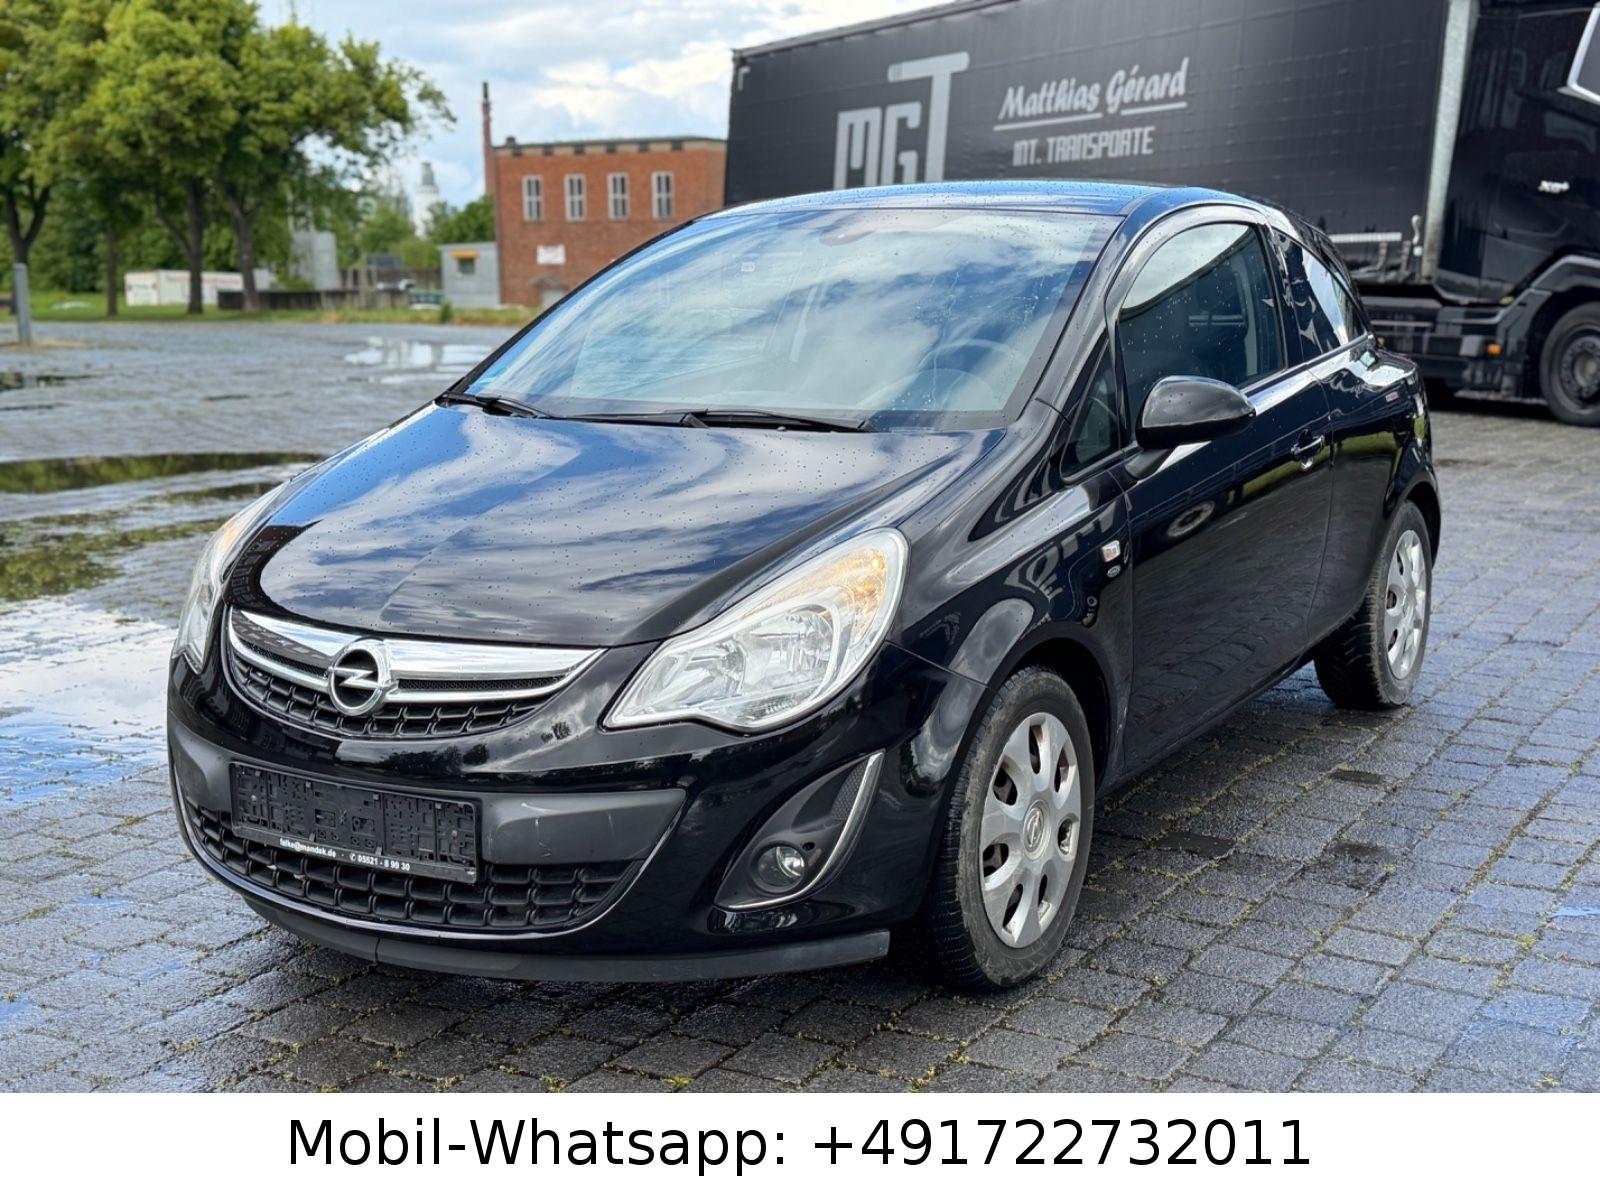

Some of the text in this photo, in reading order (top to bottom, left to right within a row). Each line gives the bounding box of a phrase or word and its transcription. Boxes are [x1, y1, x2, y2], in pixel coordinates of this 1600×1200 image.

[998, 56, 1190, 120] Matthias Gérard
[833, 51, 970, 190] MGT
[1046, 126, 1156, 163] TRANSPORTE
[357, 854, 378, 866] 05521
[401, 862, 411, 871] 30
